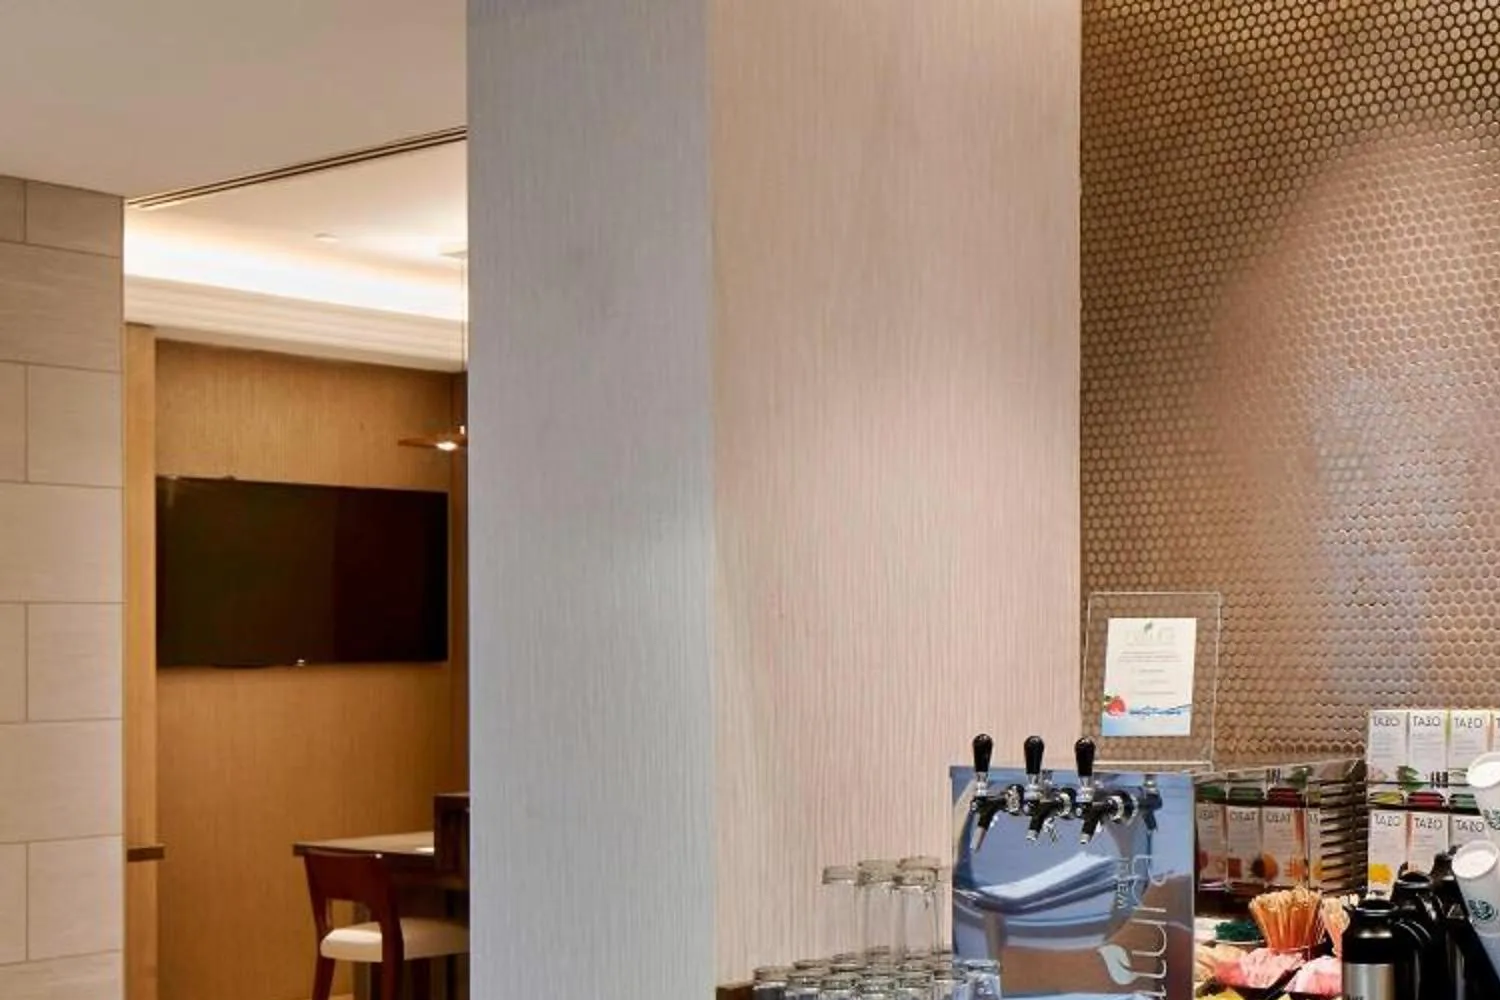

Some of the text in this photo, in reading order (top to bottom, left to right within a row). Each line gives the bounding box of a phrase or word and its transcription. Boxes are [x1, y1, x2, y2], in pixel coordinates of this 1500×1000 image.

[1373, 715, 1400, 727] TAZO
[1412, 715, 1441, 727] TAZO
[1454, 717, 1483, 729] TAZO
[1374, 813, 1400, 826] TAZO
[1414, 817, 1443, 830] TAZO
[1456, 819, 1485, 832] TAZO
